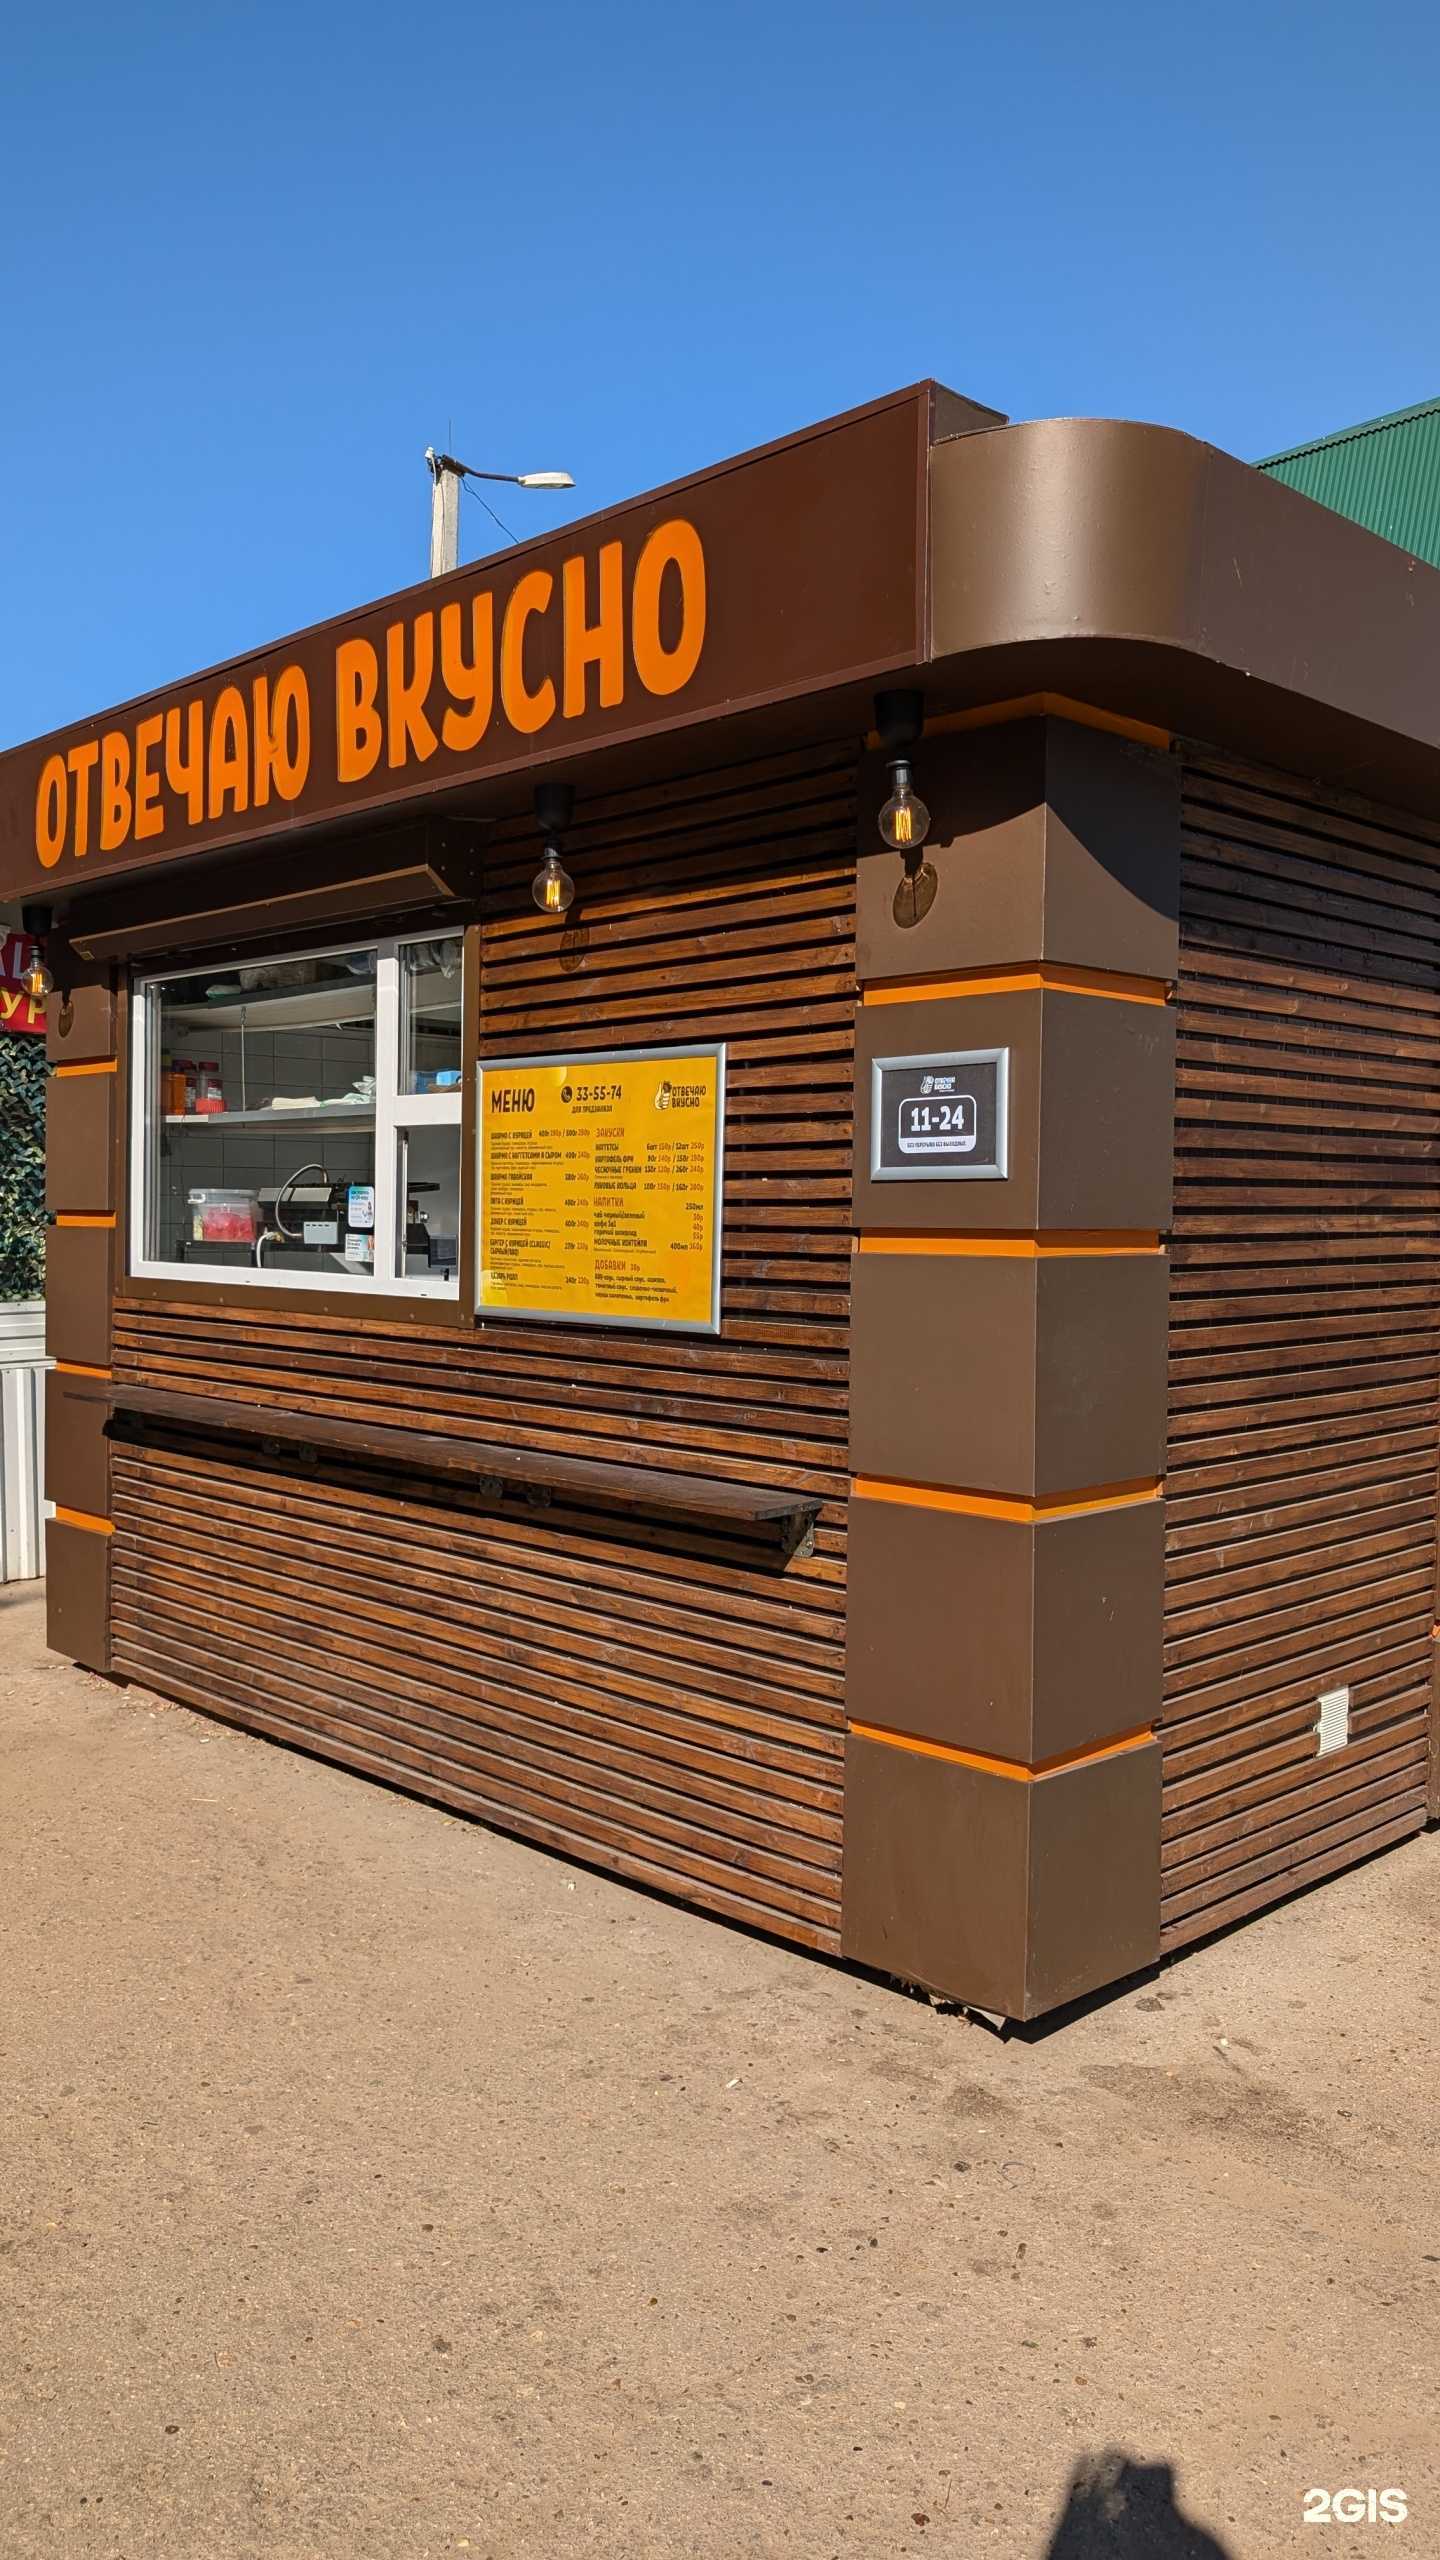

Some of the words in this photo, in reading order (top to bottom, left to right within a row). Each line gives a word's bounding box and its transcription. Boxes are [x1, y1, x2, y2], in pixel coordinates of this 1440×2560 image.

[35, 664, 310, 869] ОТВЕЧАЮ
[336, 518, 706, 783] ВКУСНО
[576, 1085, 622, 1102] 33-55-74
[672, 1085, 707, 1097] ОТВЕЧАЮ
[492, 1088, 535, 1113] МЕНЮ
[672, 1096, 700, 1108] ВКУСНО
[911, 1104, 964, 1132] 11-24
[596, 1128, 624, 1137] ЗАКУСКИ
[594, 1197, 624, 1207] НАПИТКИ
[595, 1260, 626, 1270] ДОБАВКИ
